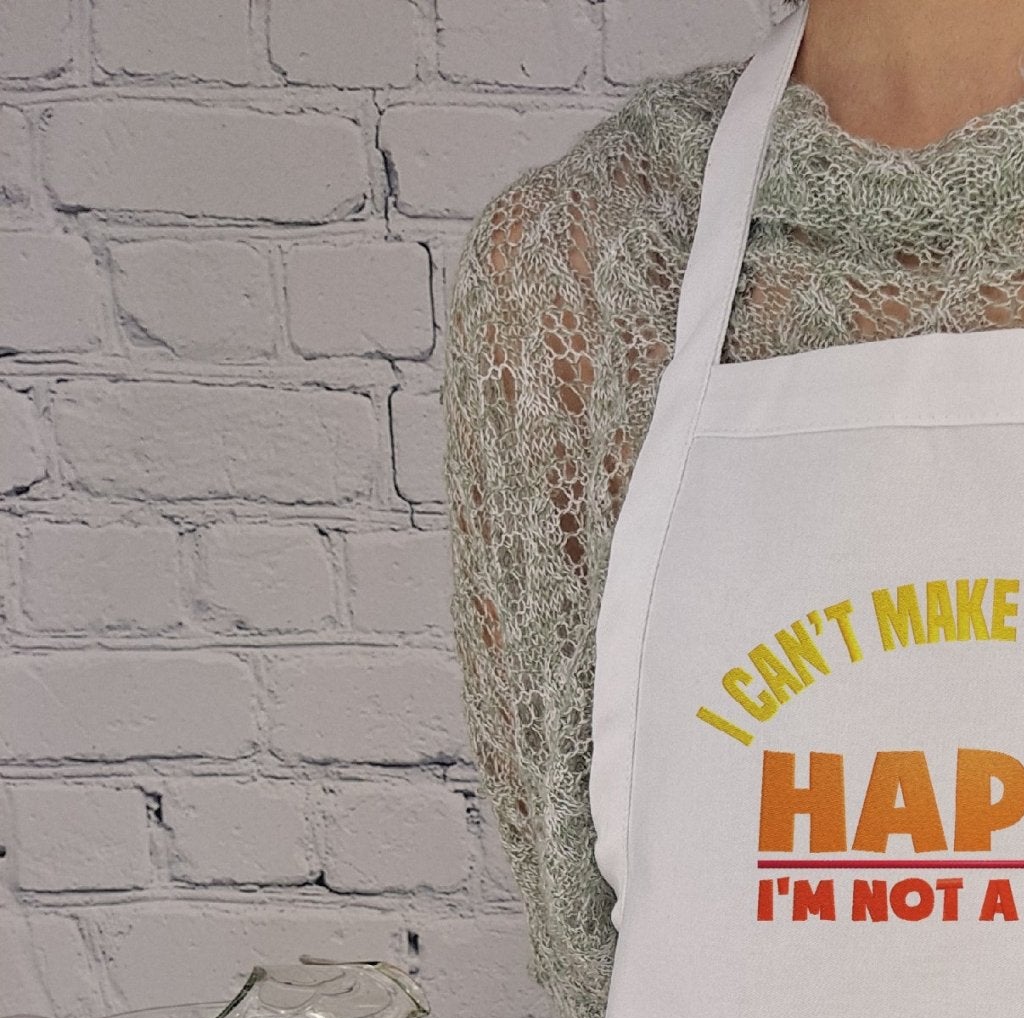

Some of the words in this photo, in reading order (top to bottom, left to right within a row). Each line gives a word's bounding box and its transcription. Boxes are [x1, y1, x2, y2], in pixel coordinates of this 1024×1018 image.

[871, 578, 1020, 651] MAKE
[721, 600, 863, 722] CAN'T
[696, 706, 754, 746] I
[757, 877, 836, 922] I'M
[852, 877, 964, 922] NOT
[979, 879, 1019, 922] A
